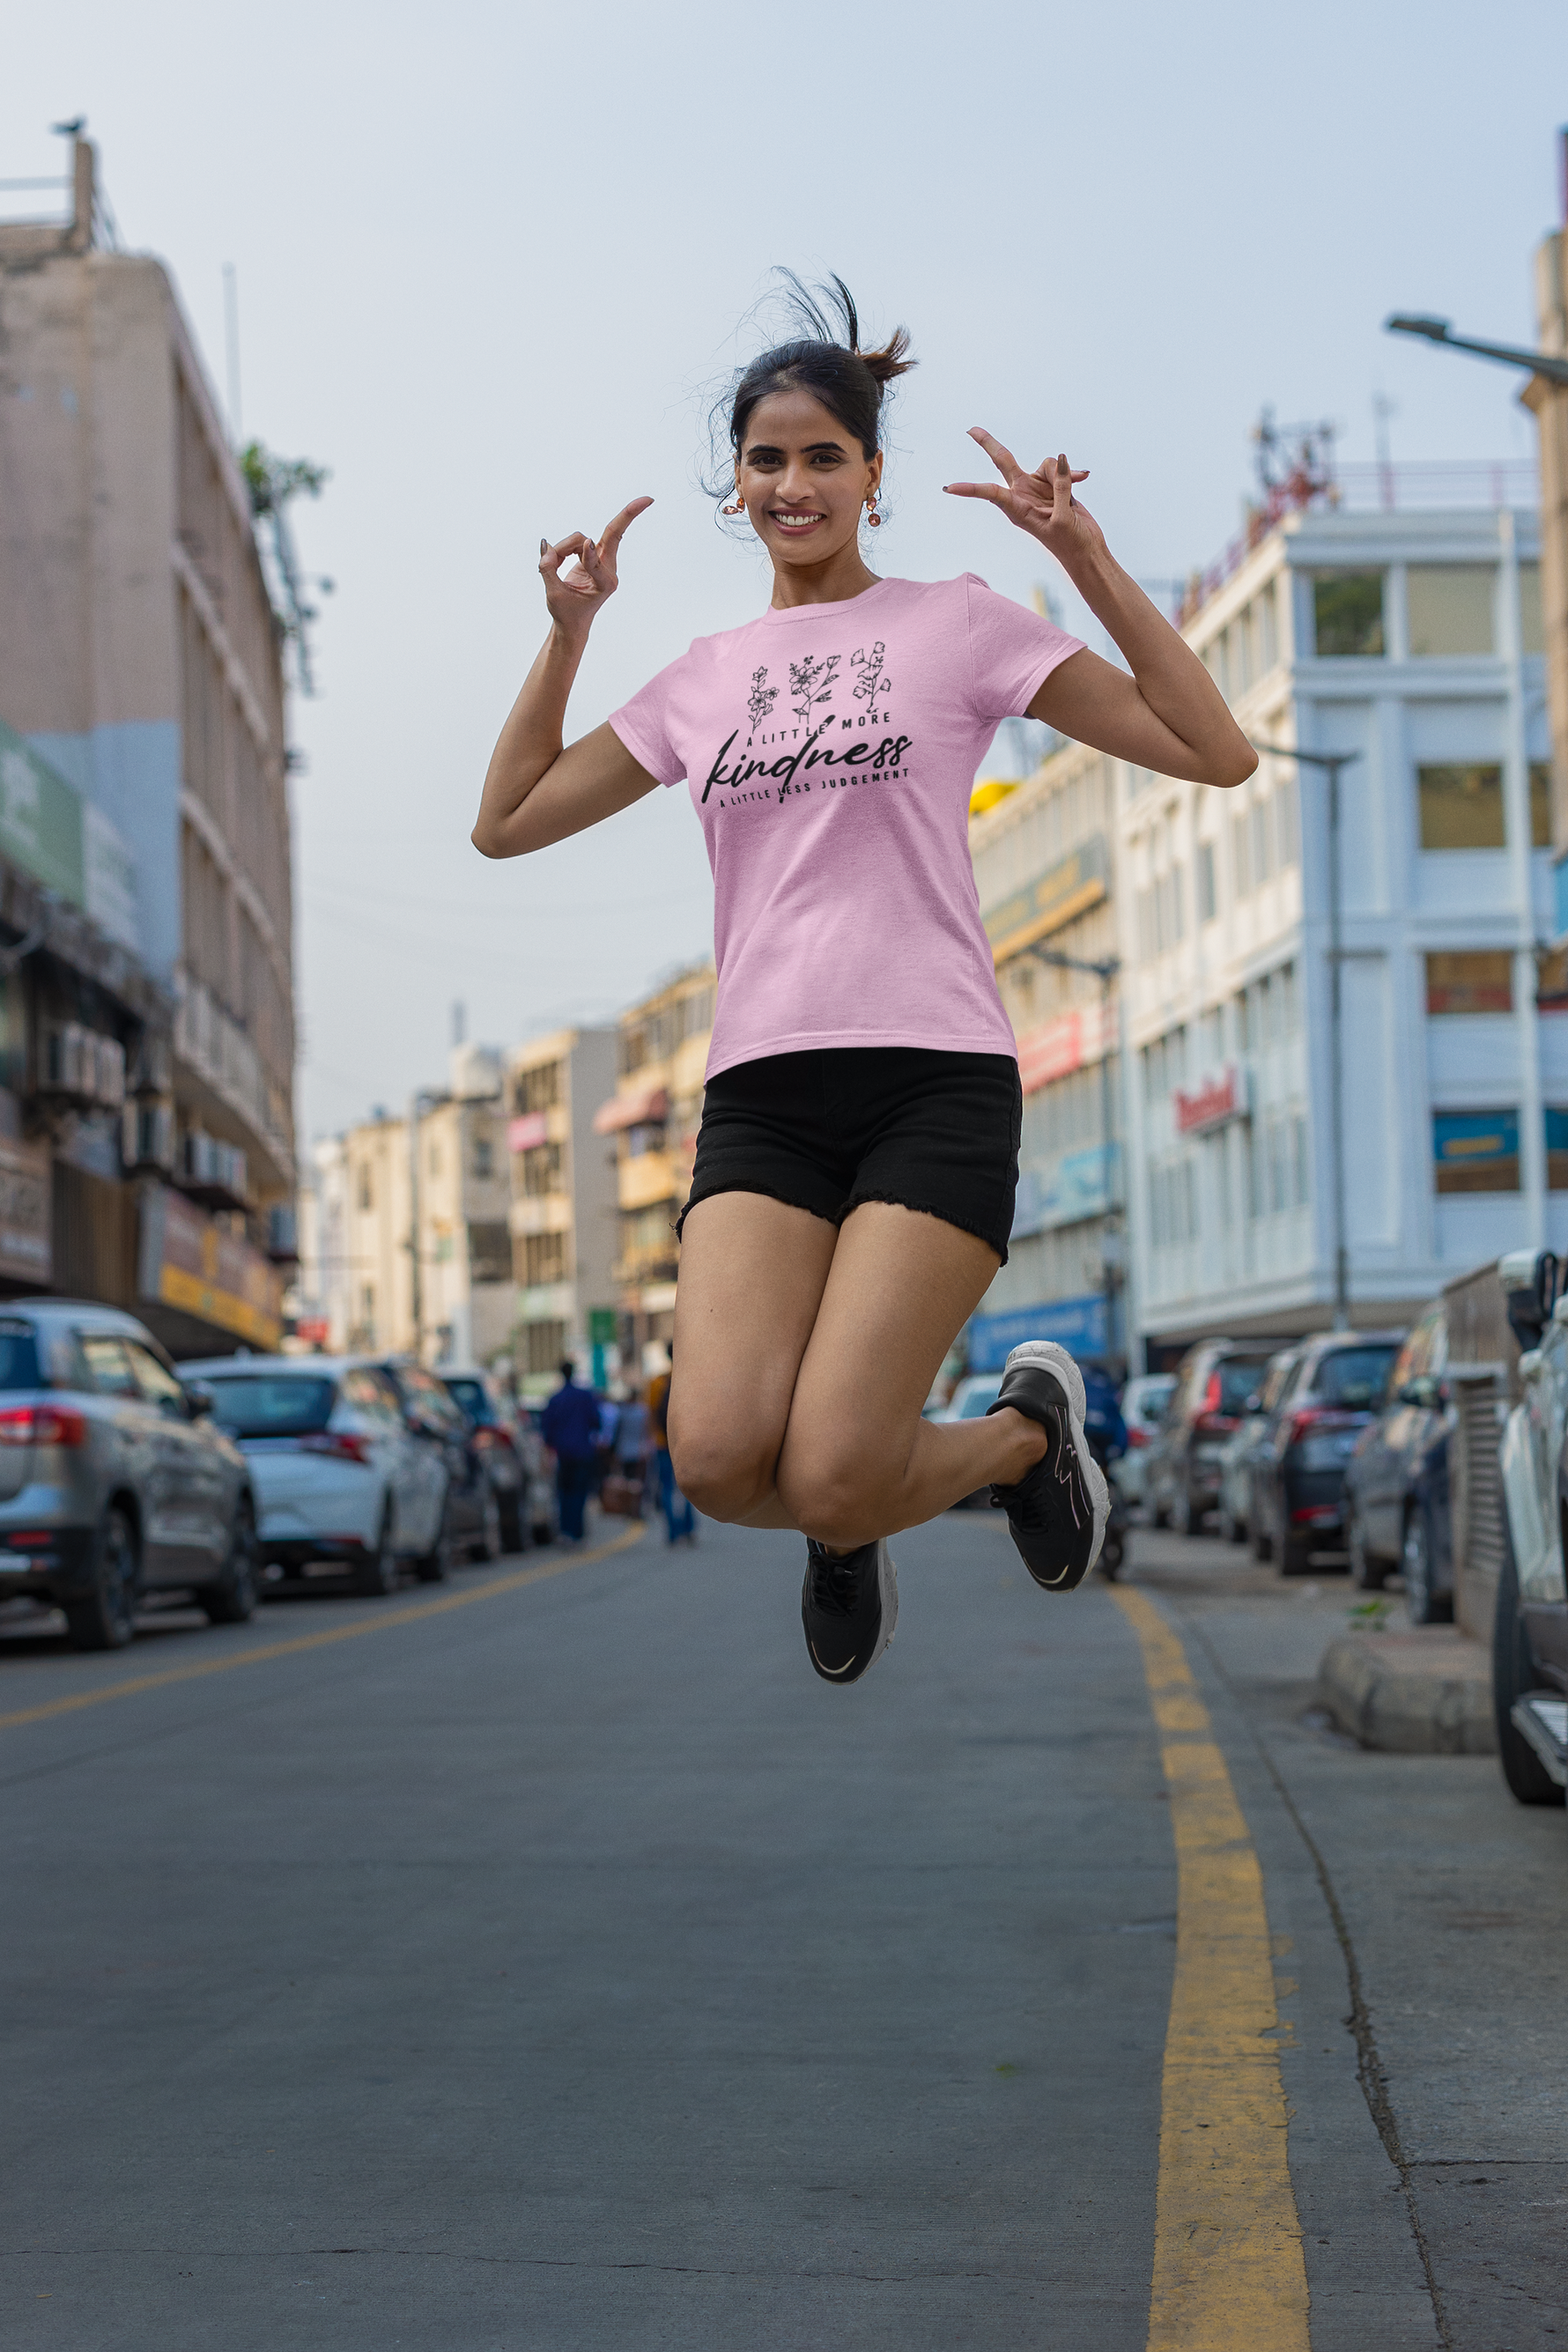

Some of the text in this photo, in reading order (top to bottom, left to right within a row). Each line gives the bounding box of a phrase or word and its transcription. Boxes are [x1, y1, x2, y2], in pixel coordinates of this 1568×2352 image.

[747, 712, 891, 747] A LITTLE MORE
[701, 714, 913, 803] kindness
[720, 768, 909, 808] A LITTLE LESS JUDGEMENT
